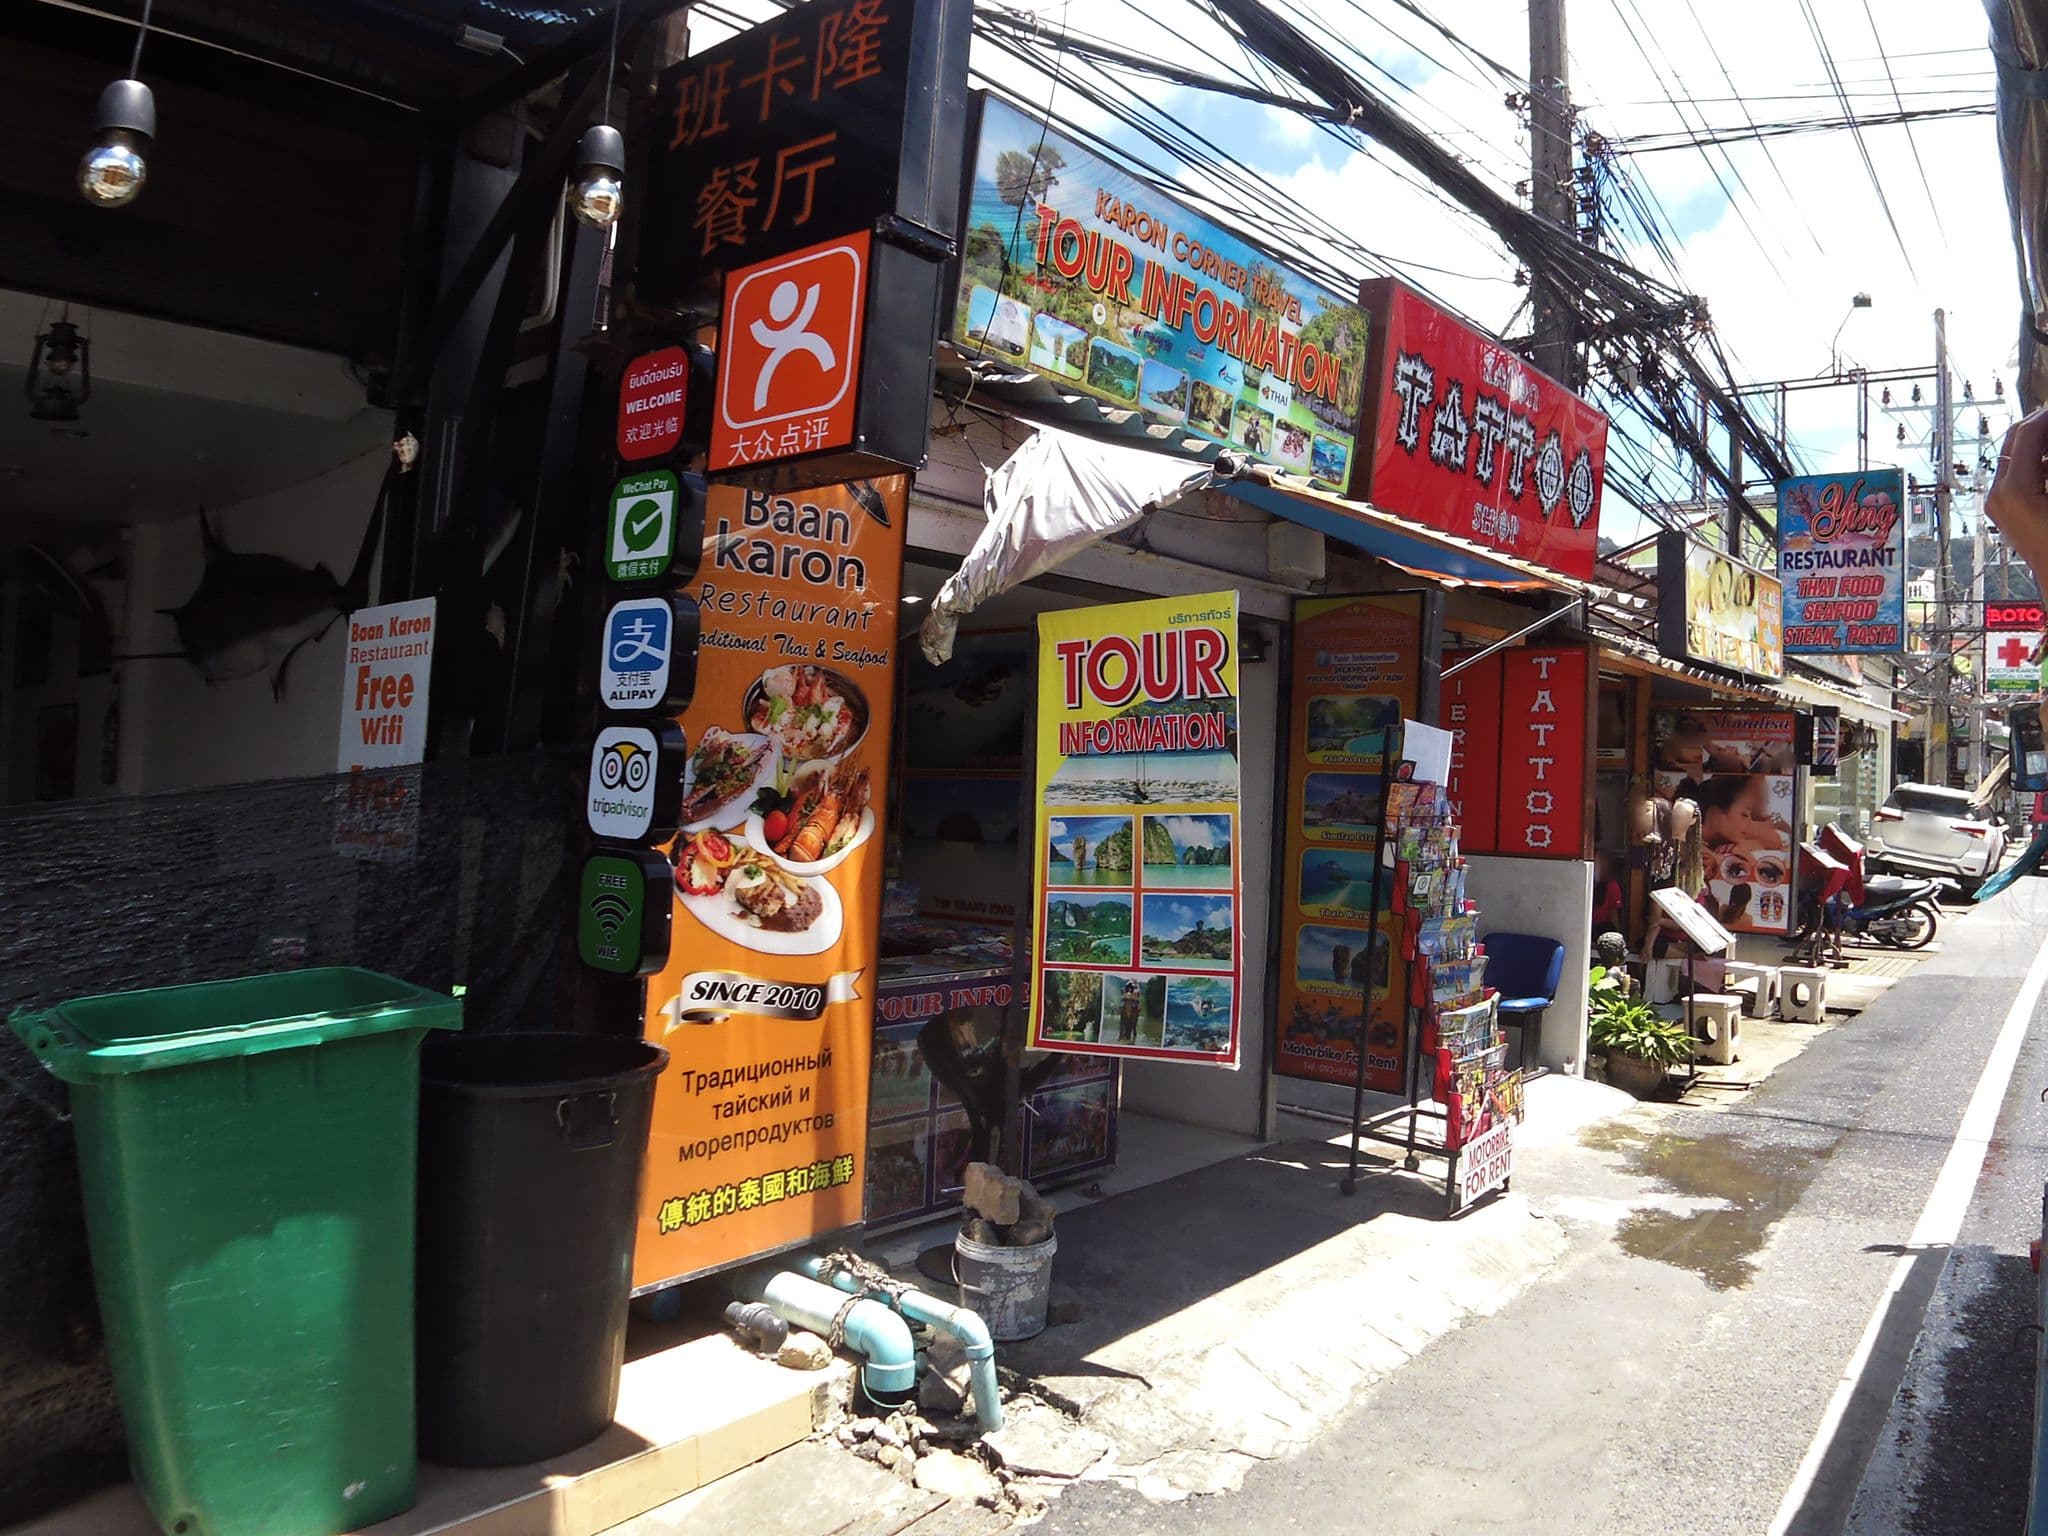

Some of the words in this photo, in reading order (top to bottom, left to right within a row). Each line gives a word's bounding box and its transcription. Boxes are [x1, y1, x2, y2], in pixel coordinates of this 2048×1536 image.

[669, 0, 889, 150] 班卡隆
[694, 131, 838, 257] 餐厅
[1095, 188, 1168, 252] KARON
[1172, 232, 1247, 295] CORNER
[1251, 274, 1303, 327] TRAVEL
[1035, 201, 1134, 304] TOUR
[1140, 259, 1342, 403] INFORMATION
[626, 389, 682, 414] WELCOME
[1270, 389, 1289, 407] THAI
[625, 416, 679, 443] 欢迎光临
[728, 416, 830, 466] 大众点评
[1393, 347, 1595, 528] TATTOO
[623, 480, 652, 494] WeChat
[653, 478, 667, 492] Pay
[743, 488, 851, 546] Baan
[1810, 478, 1899, 548] Ying
[617, 559, 660, 578] 微信支付
[1783, 548, 1896, 570] RESTAURANT
[1797, 577, 1835, 598] THAI
[1838, 575, 1885, 597] FOOD
[698, 583, 875, 632] Restaurant
[1168, 607, 1231, 625] บริการทัวร์
[1803, 601, 1879, 622] SEAFOOD
[1989, 608, 2042, 622] BOTO
[352, 622, 384, 643] Baan
[389, 614, 431, 638] Karon
[1846, 624, 1898, 646] PASTA
[350, 640, 429, 664] Restaurant
[698, 629, 767, 653] aditional
[773, 633, 810, 658] Thai
[814, 639, 826, 659] &
[832, 641, 889, 669] Seafood
[616, 671, 651, 687] 支付宝
[1056, 627, 1232, 710] TOUR
[355, 665, 415, 712] Free
[610, 688, 657, 701] ALIPAY
[361, 715, 404, 745] Wifi
[1059, 711, 1226, 757] INFORMATION
[1525, 656, 1557, 848] TATTOO
[593, 798, 649, 819] tripadvisor
[599, 874, 627, 888] FREE
[690, 981, 762, 1005] SINCE
[768, 986, 821, 1010] 2010
[682, 1049, 832, 1095] Традиционный
[1282, 1040, 1344, 1062] Motorbike
[1368, 1052, 1399, 1071] Rent
[712, 1085, 793, 1121] тайский
[799, 1086, 810, 1104] и
[678, 1113, 834, 1162] морепродуктов
[1468, 1126, 1510, 1170] MOTORBIKE
[1465, 1165, 1486, 1200] FOR
[1488, 1149, 1512, 1184] RENT
[658, 1155, 854, 1235] 傳統的泰國和海鮮
